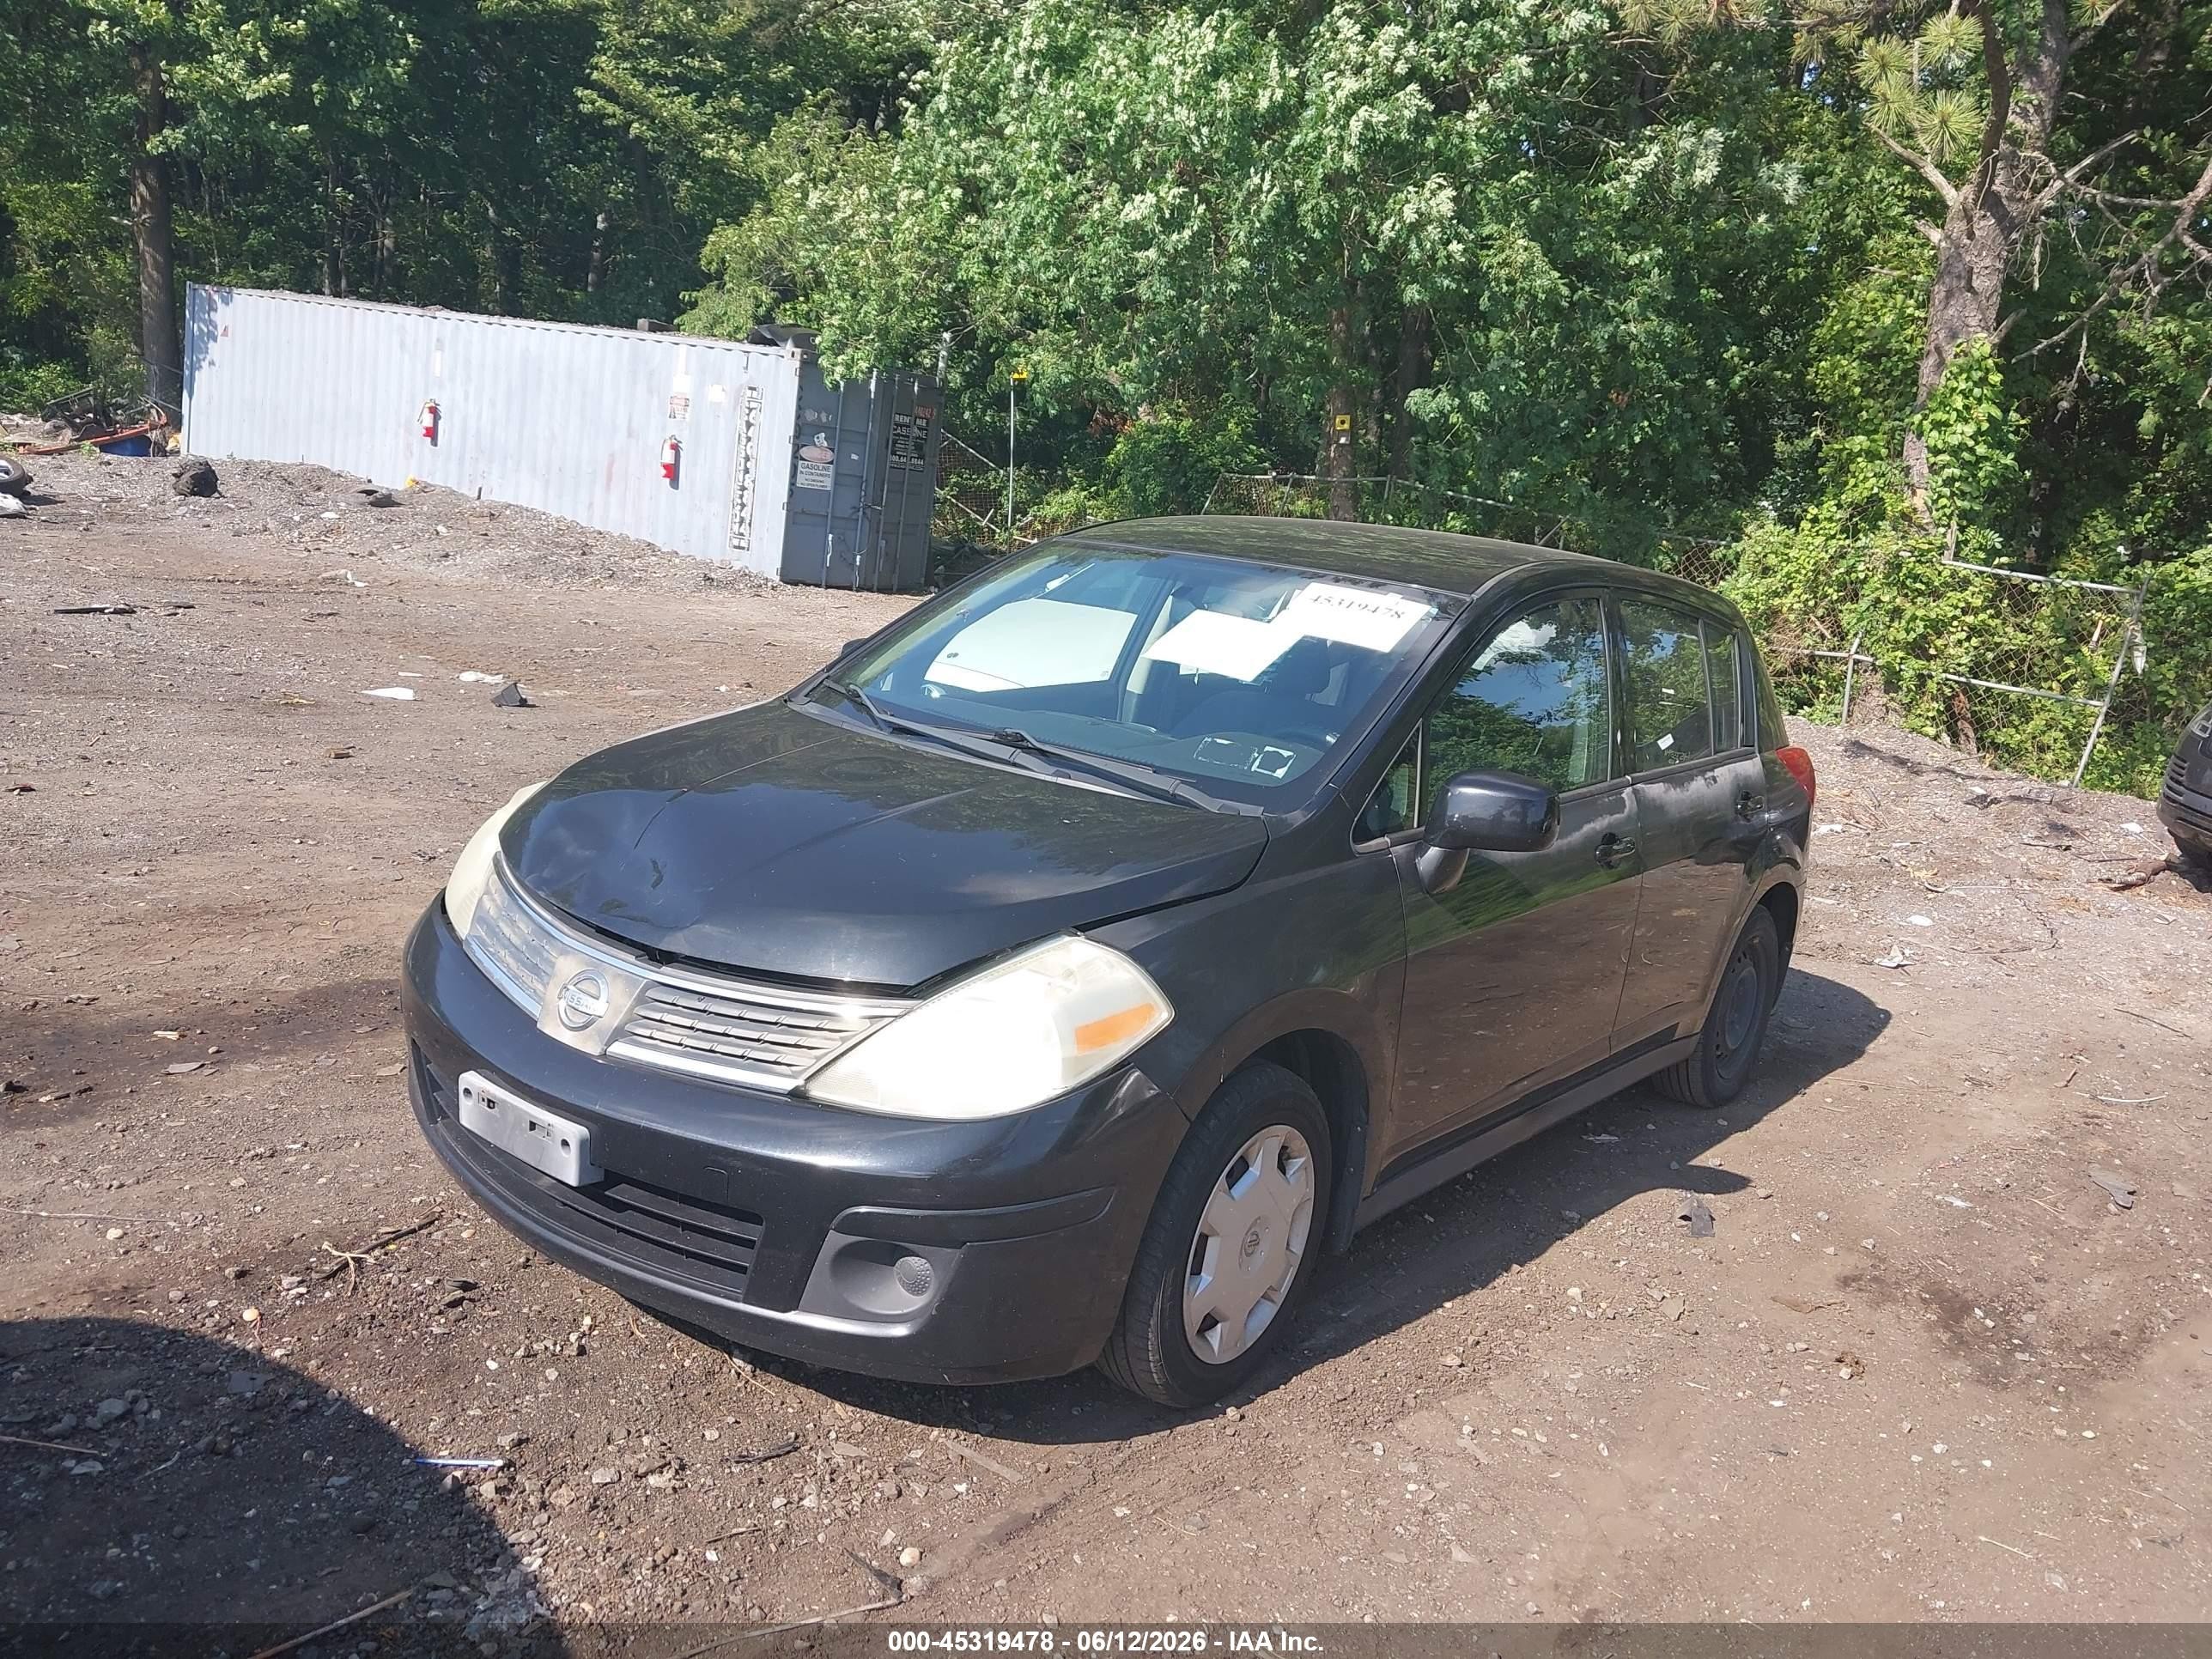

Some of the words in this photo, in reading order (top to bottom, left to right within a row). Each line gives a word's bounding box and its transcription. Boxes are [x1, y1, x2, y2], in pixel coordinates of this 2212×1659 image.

[895, 414, 912, 423] RENT
[893, 425, 927, 439] CASSNE
[800, 463, 831, 472] GASOLINE
[1310, 594, 1406, 619] 45319478
